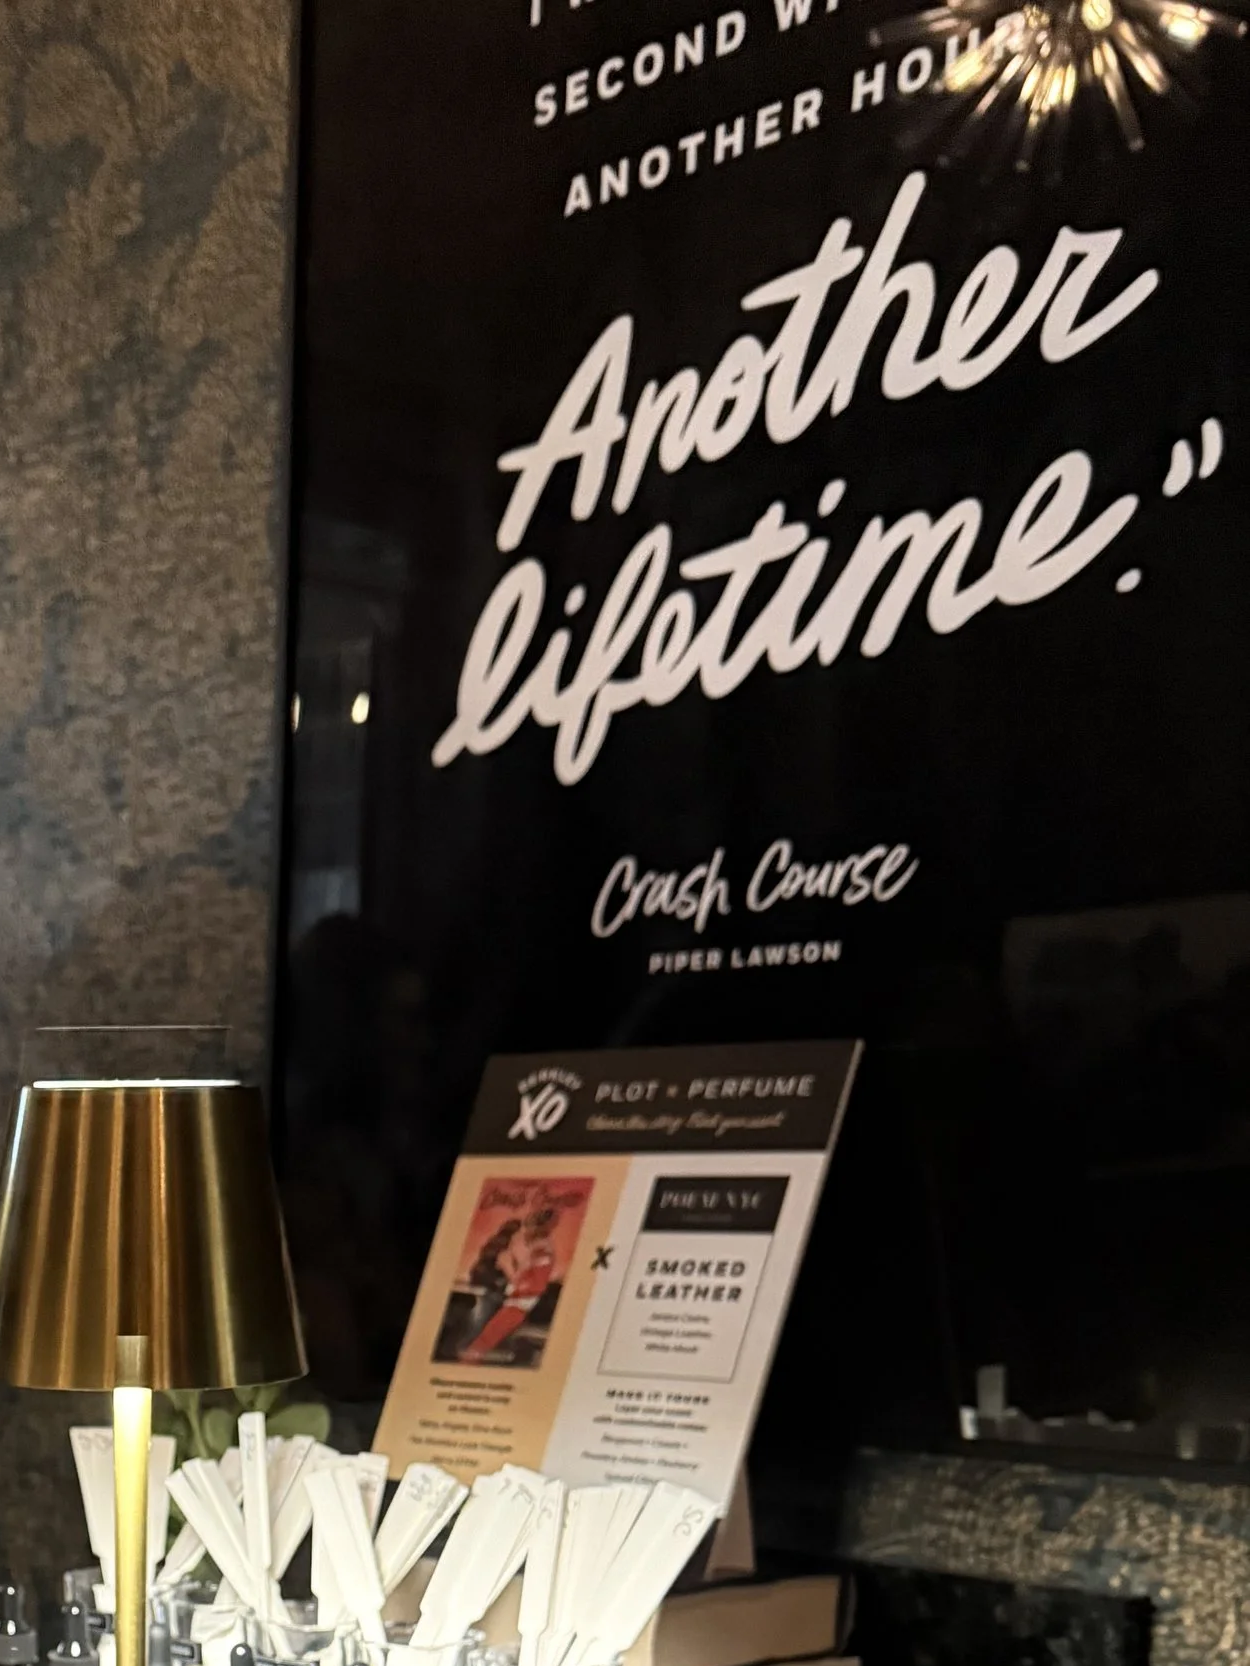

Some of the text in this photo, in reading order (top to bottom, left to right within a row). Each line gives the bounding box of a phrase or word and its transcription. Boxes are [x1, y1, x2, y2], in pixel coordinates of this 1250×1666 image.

[534, 11, 746, 126] SECOND
[564, 89, 824, 218] ANOTHER
[497, 170, 1160, 552] Another
[591, 838, 920, 938] Crash Course
[647, 939, 843, 974] PIPER LAWSON
[507, 1082, 570, 1141] XO
[594, 1074, 816, 1103] PLOT PERFUME
[635, 1283, 743, 1302] LEATHER
[645, 1258, 746, 1277] SMOKED
